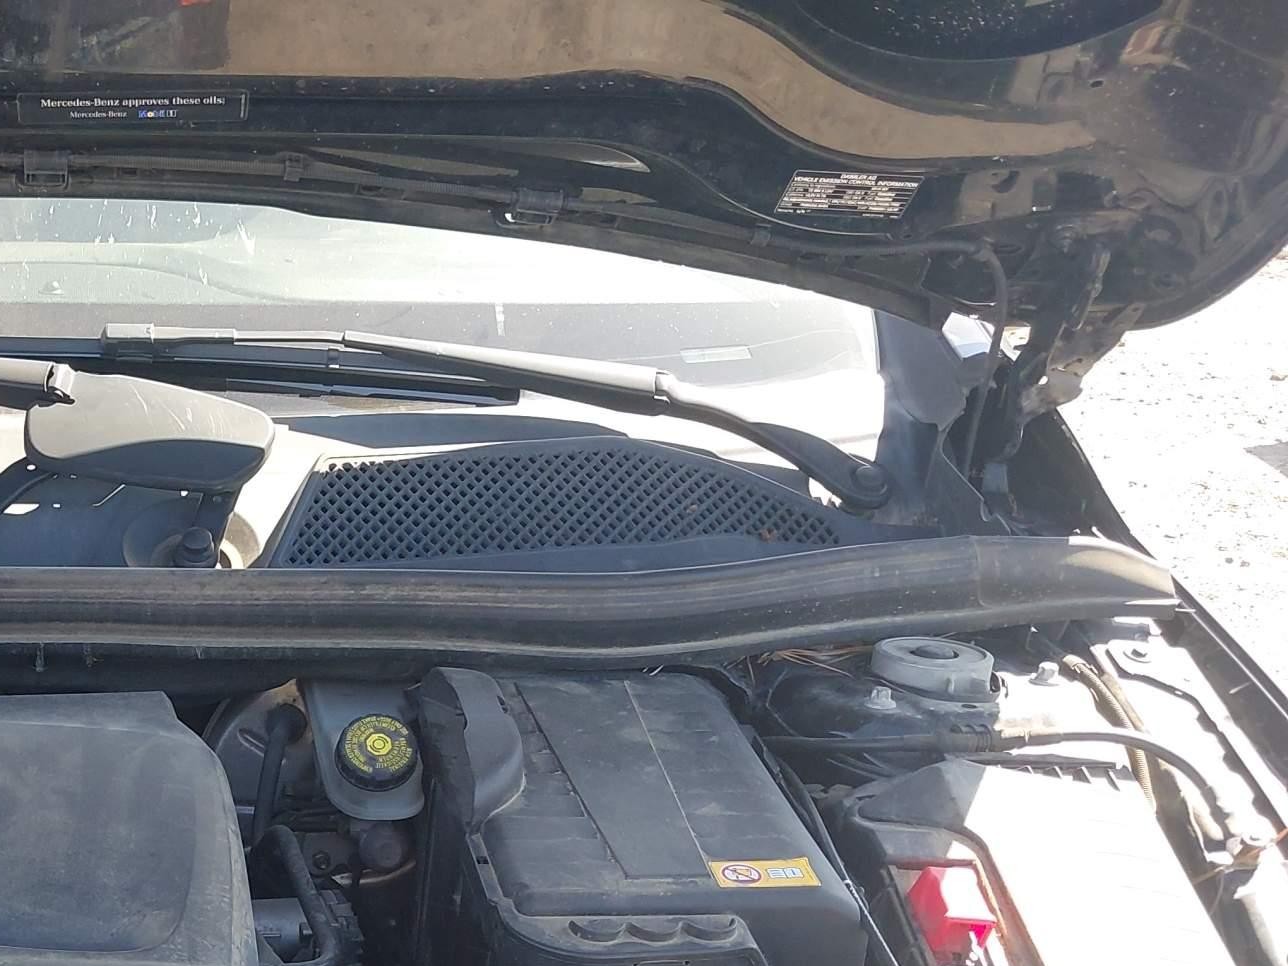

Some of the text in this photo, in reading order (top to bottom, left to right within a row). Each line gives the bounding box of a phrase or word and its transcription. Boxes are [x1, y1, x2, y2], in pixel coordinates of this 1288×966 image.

[40, 97, 119, 108] Mercedes-Benz
[122, 97, 170, 108] approves
[172, 96, 201, 106] these
[70, 110, 128, 119] Mercedes-Benz
